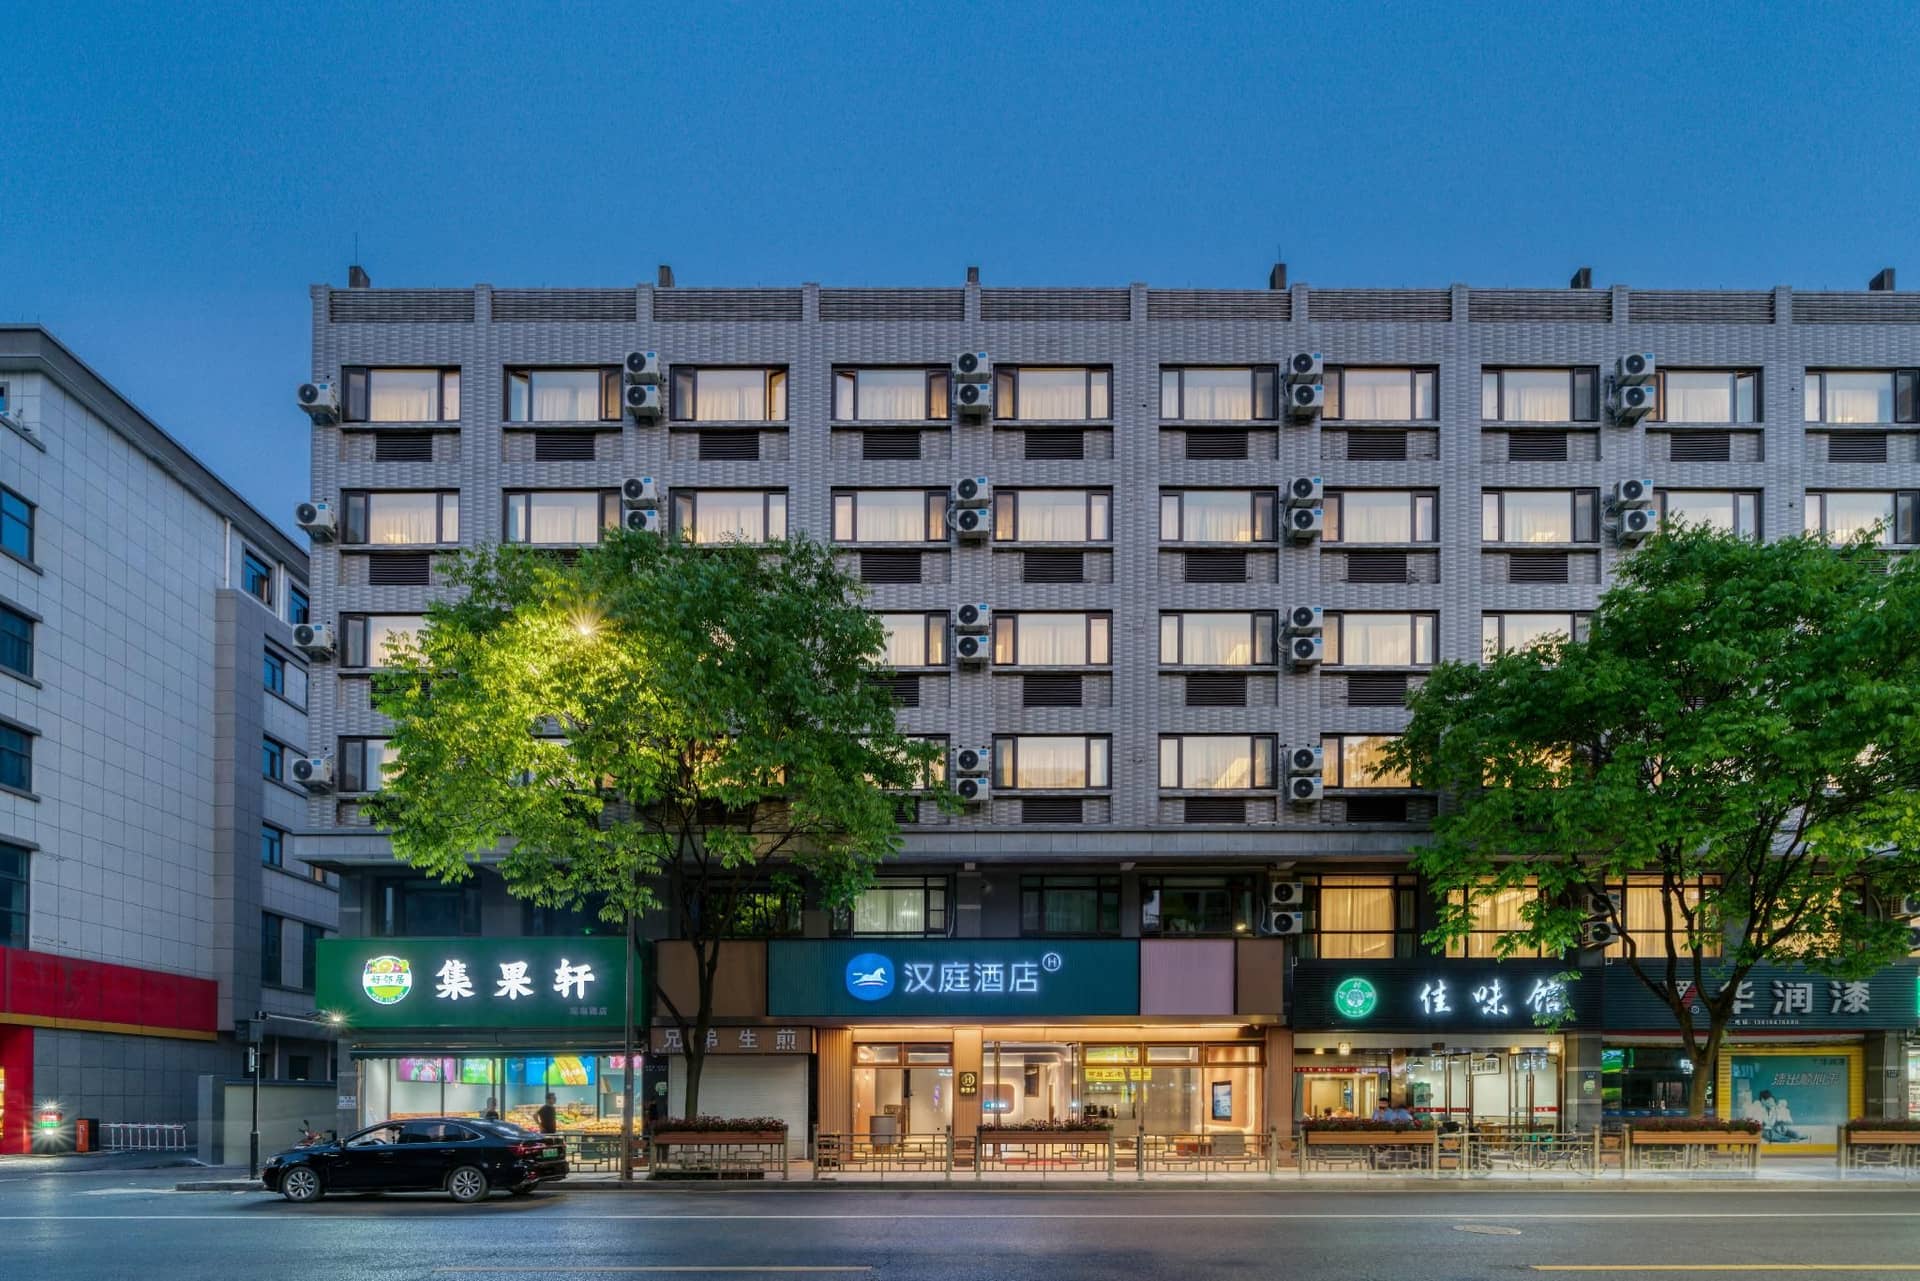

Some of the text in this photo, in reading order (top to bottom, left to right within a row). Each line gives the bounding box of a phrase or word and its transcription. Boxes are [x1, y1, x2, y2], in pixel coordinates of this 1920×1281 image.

[435, 958, 596, 1001] 集果轩
[904, 961, 1038, 992] 汉庭酒店
